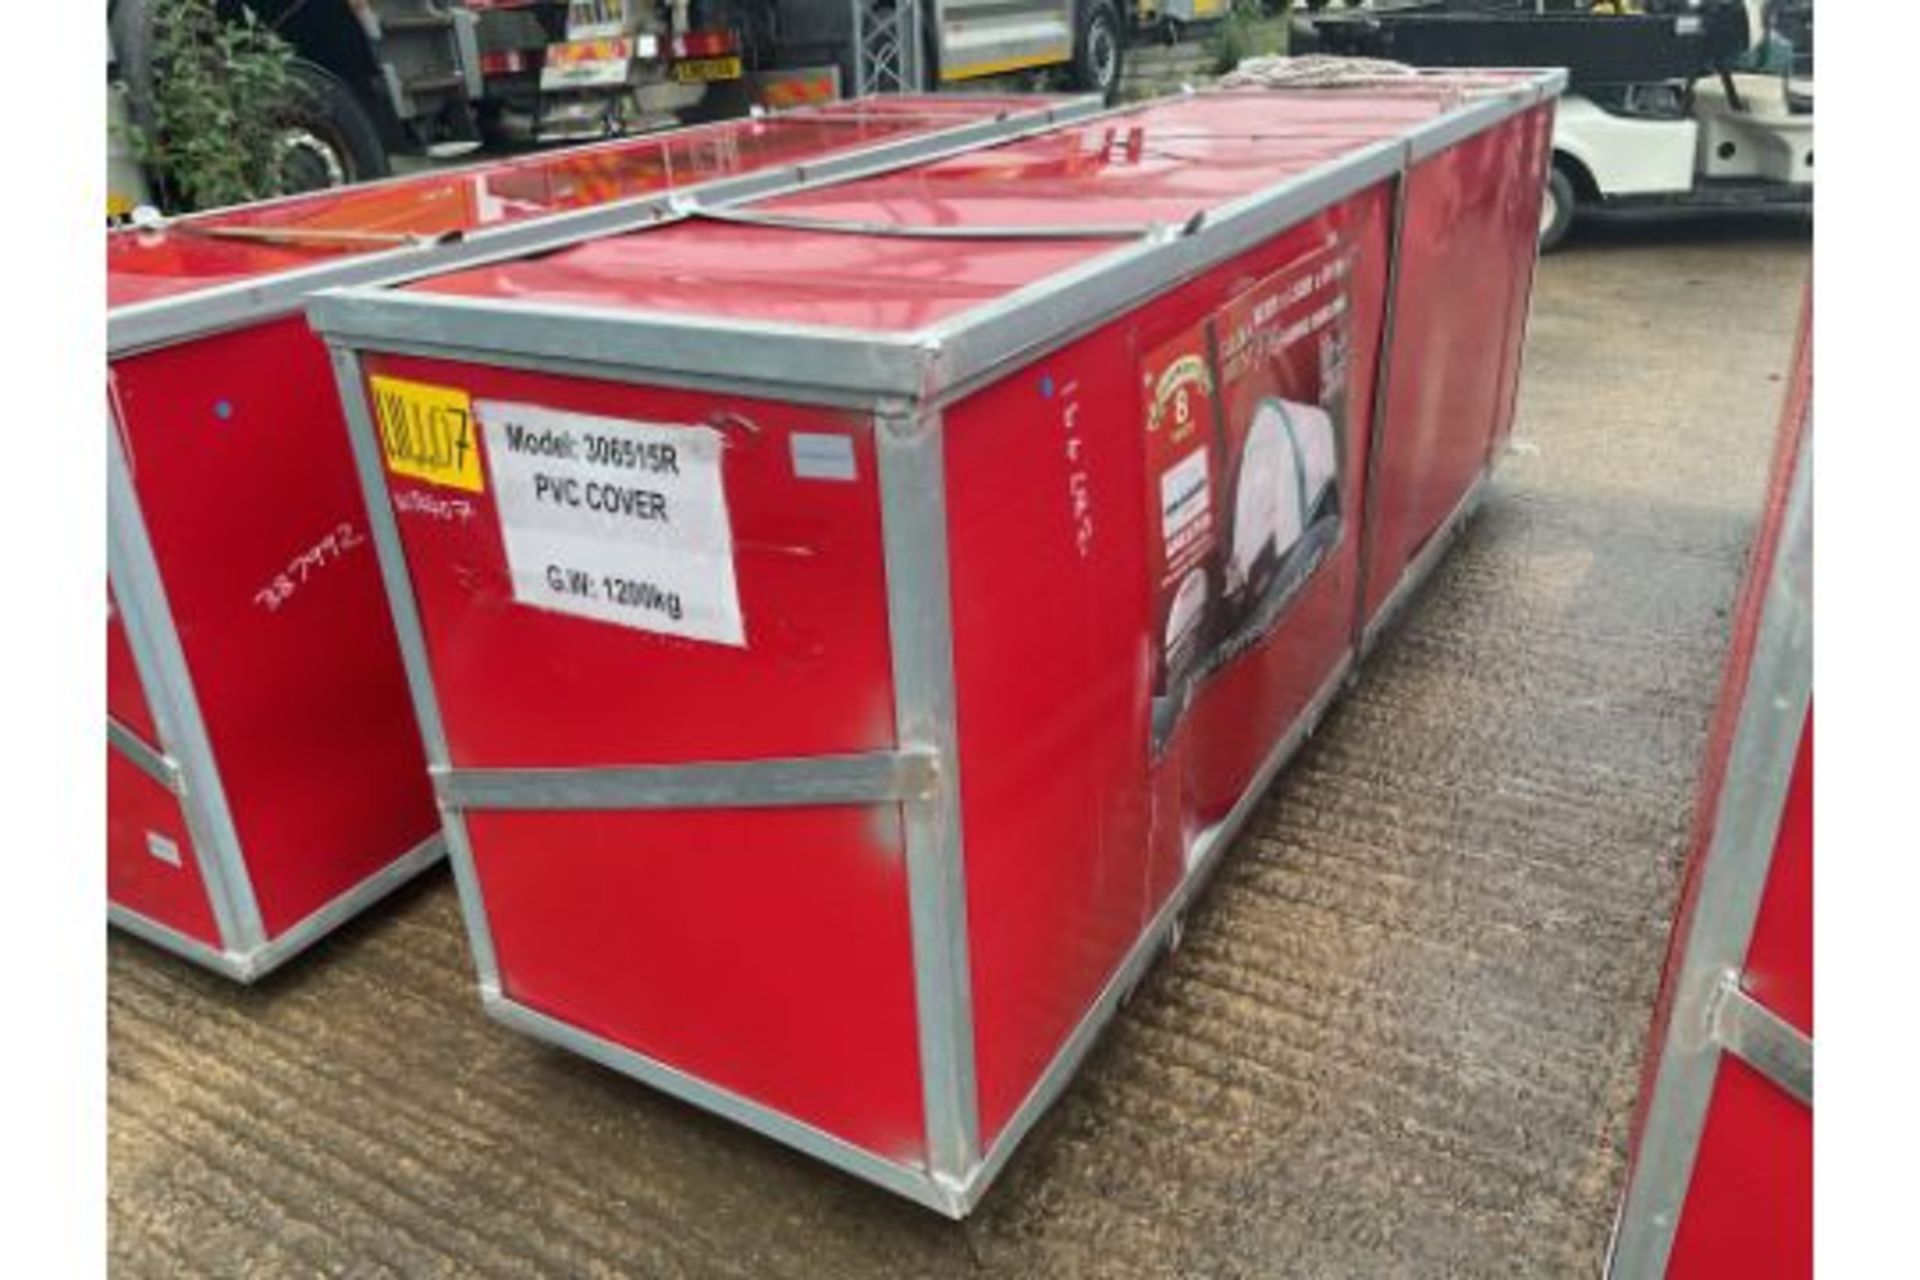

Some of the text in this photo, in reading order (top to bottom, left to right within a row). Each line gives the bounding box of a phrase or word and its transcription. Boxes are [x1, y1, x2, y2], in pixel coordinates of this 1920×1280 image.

[505, 422, 680, 476] Model: 306515R
[534, 472, 669, 522] PVC COVER
[546, 564, 683, 621] G.W: 1200kg
